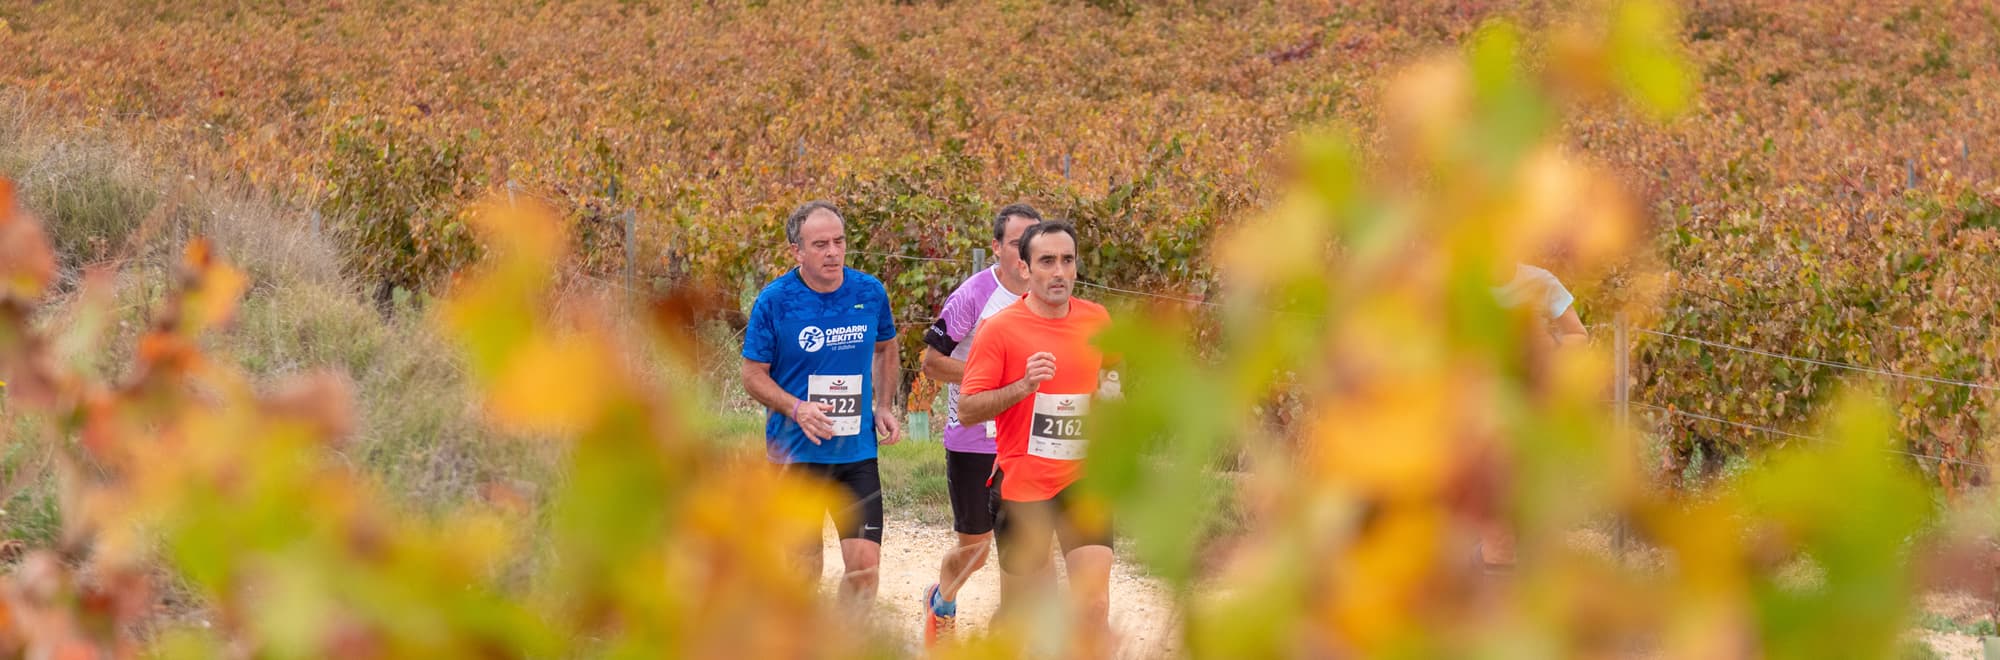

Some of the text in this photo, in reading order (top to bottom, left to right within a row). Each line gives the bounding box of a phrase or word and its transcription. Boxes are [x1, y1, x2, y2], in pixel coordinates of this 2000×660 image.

[825, 324, 868, 336] ONDARRU
[826, 332, 864, 343] LEKITTO
[1042, 418, 1082, 436] 2162
